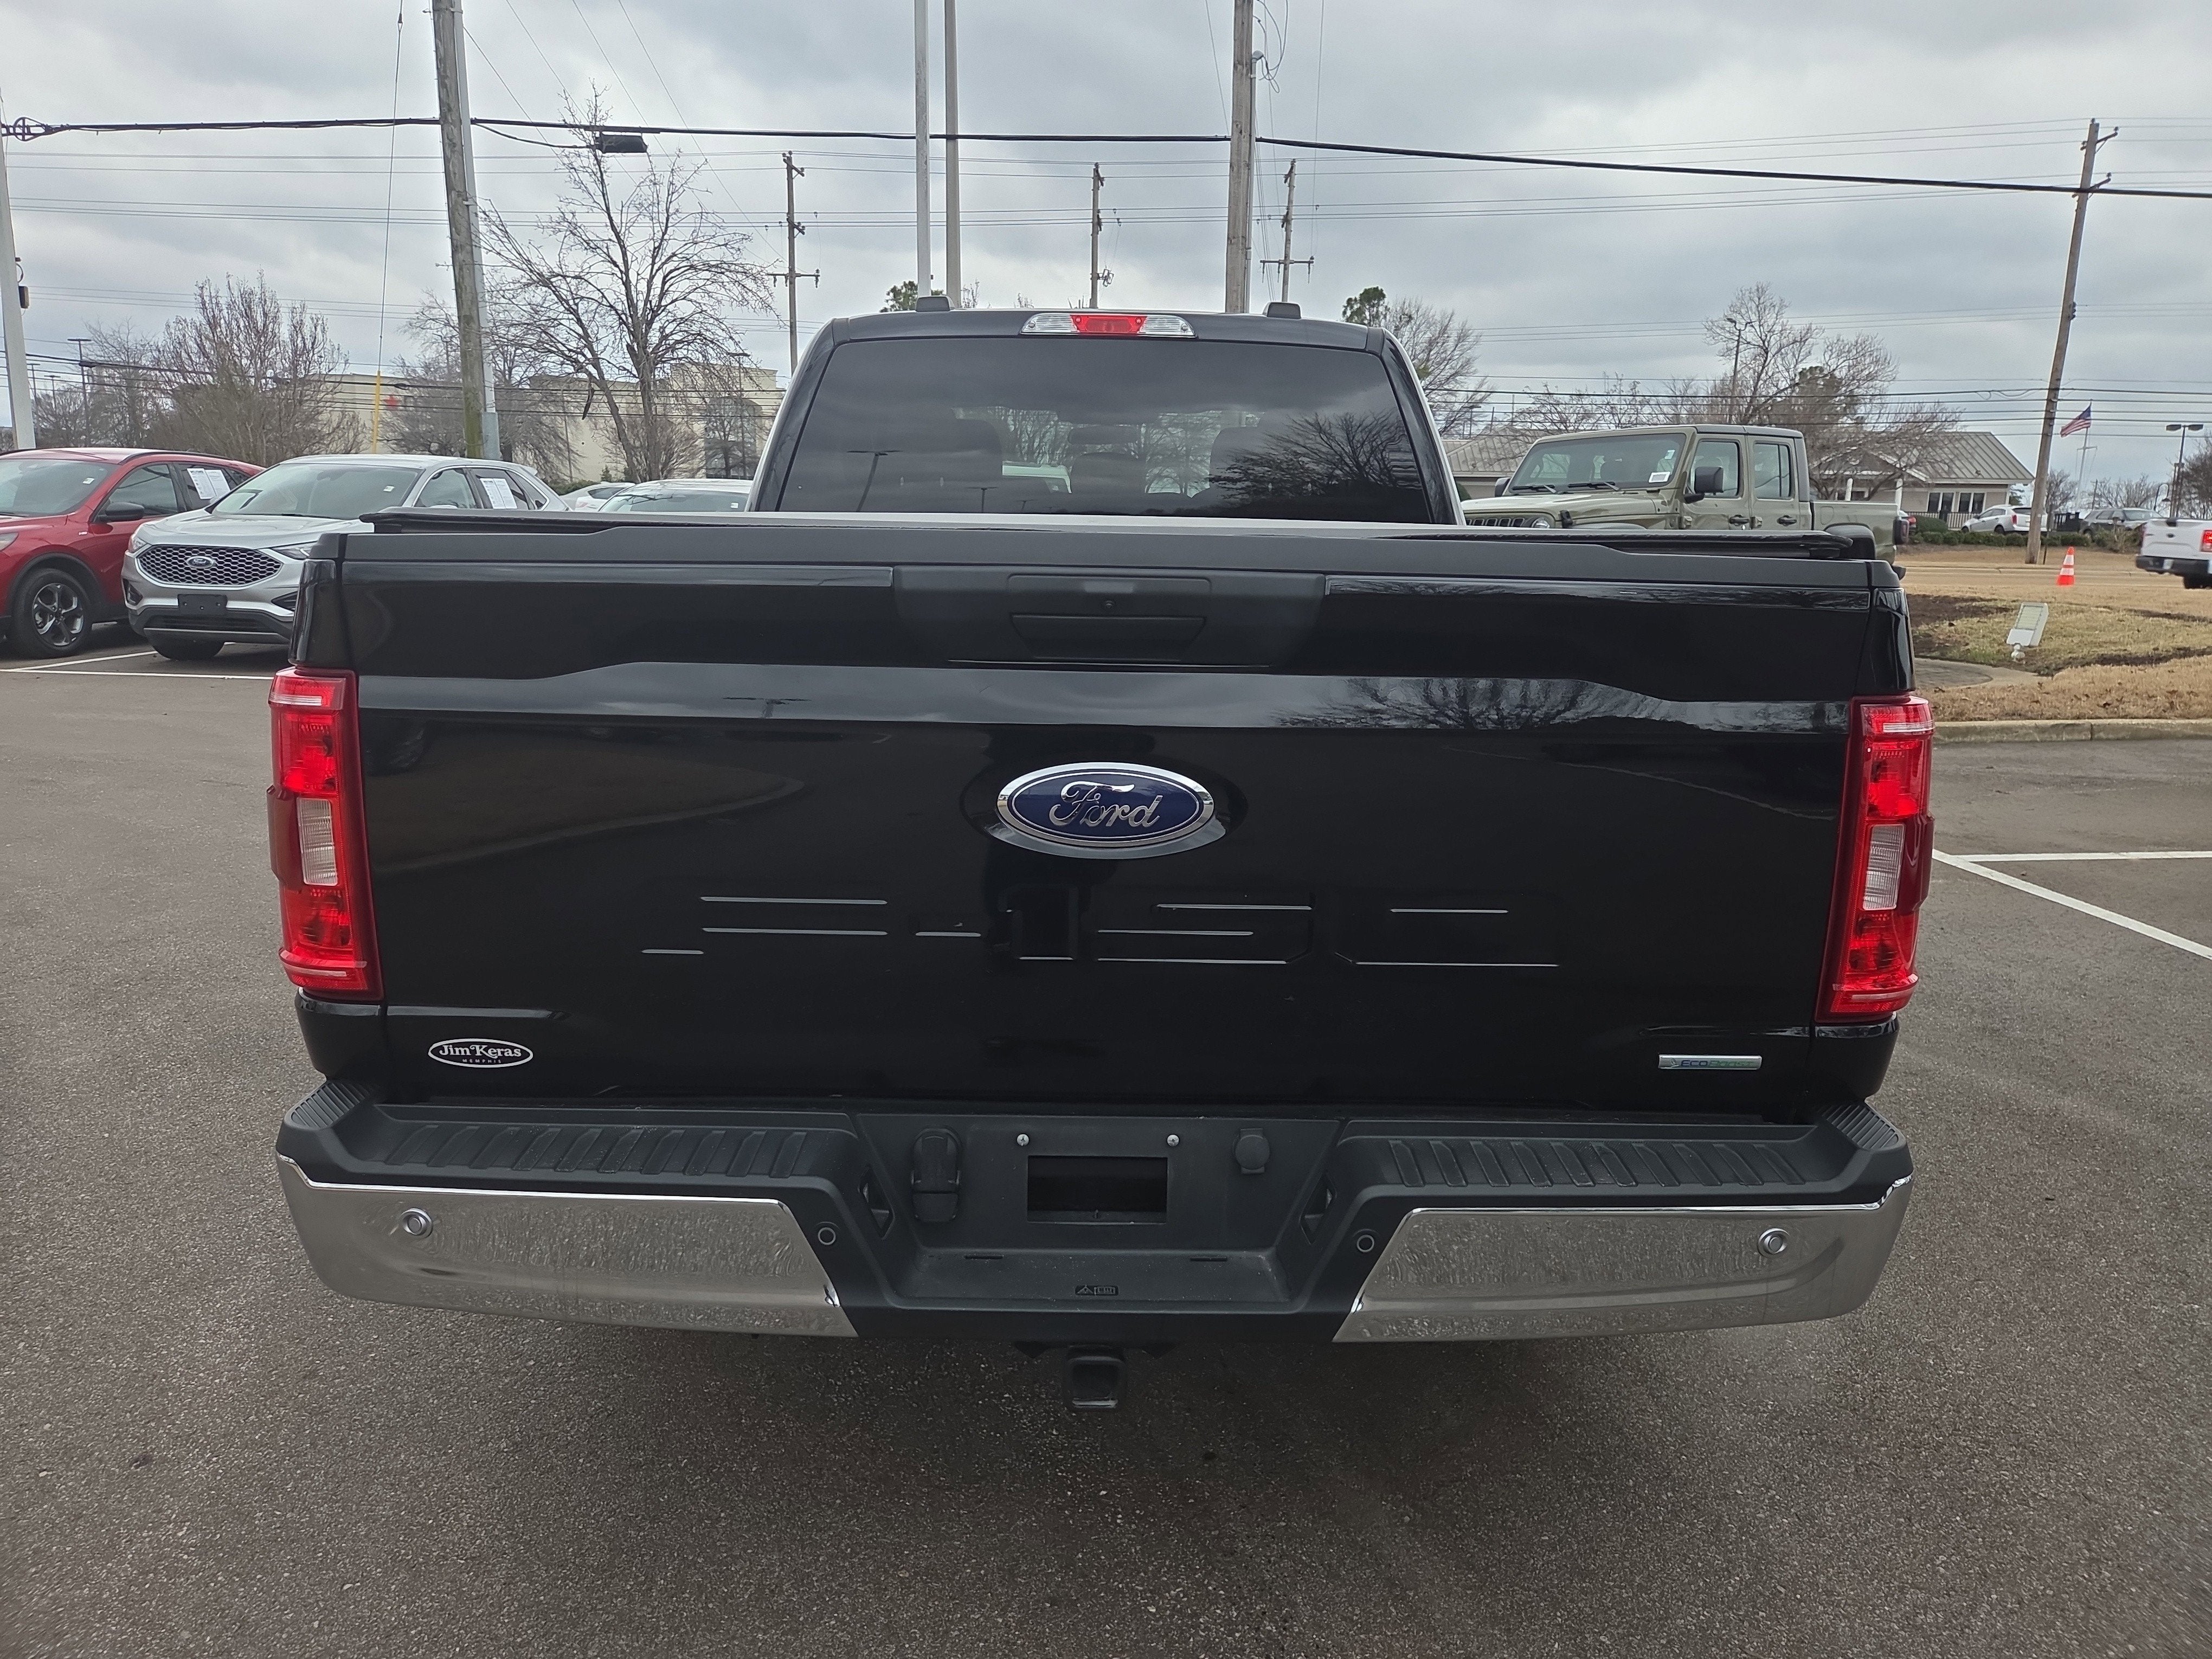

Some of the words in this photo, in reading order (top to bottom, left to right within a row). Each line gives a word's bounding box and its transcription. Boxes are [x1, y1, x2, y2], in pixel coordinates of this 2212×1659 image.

[1049, 781, 1163, 827] Ford
[439, 1044, 471, 1056] Jim
[470, 1044, 522, 1059] Keras
